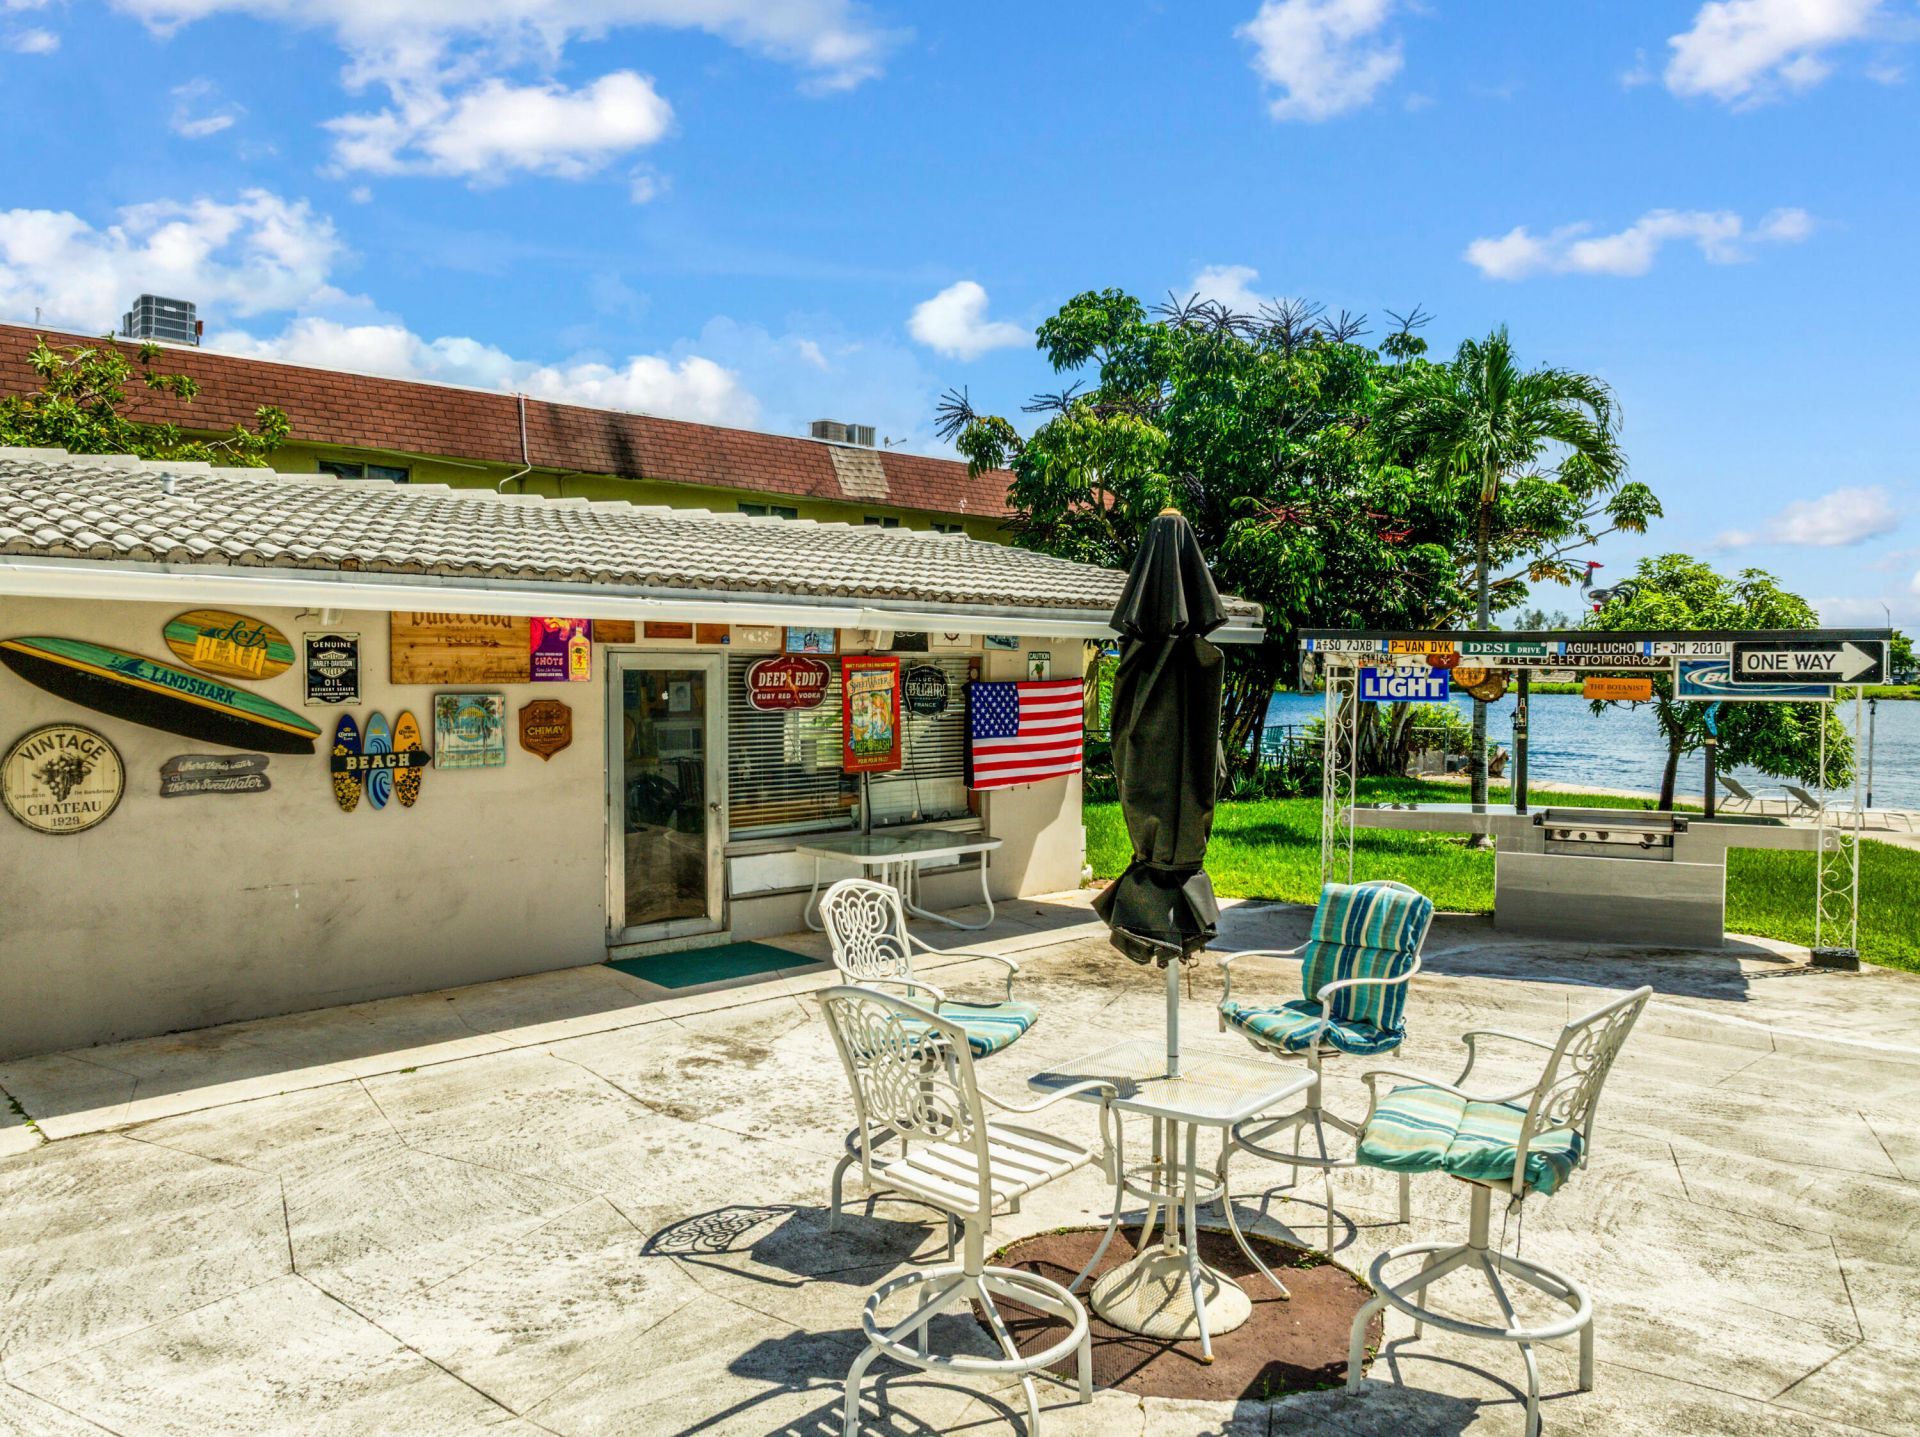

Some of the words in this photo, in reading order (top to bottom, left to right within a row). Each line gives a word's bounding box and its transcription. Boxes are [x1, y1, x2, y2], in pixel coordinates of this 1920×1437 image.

[1347, 641, 1372, 651] 7JXB
[1391, 640, 1425, 652] P-VAN
[1431, 642, 1450, 652] DYK
[1469, 643, 1510, 653] DESI
[1566, 643, 1635, 654] AGUI-LUCHO
[1692, 643, 1722, 654] 2010
[193, 635, 267, 677] BEACH
[1539, 654, 1576, 665] BEER
[1582, 655, 1665, 666] TOMORROW
[1747, 654, 1788, 670] ONE
[1794, 654, 1837, 670] WAY
[1376, 666, 1433, 678] BUD
[1702, 672, 1731, 683] BU
[758, 672, 787, 686] DEEP
[795, 672, 824, 686] EDDY
[151, 666, 236, 705] LANDSHARK
[1365, 679, 1444, 697] LIGHT
[527, 726, 566, 736] CHIMAY
[18, 734, 107, 761] VINTAGE
[346, 753, 410, 770] BEACH
[27, 801, 103, 816] CHATEAU
[51, 816, 80, 827] 1929
